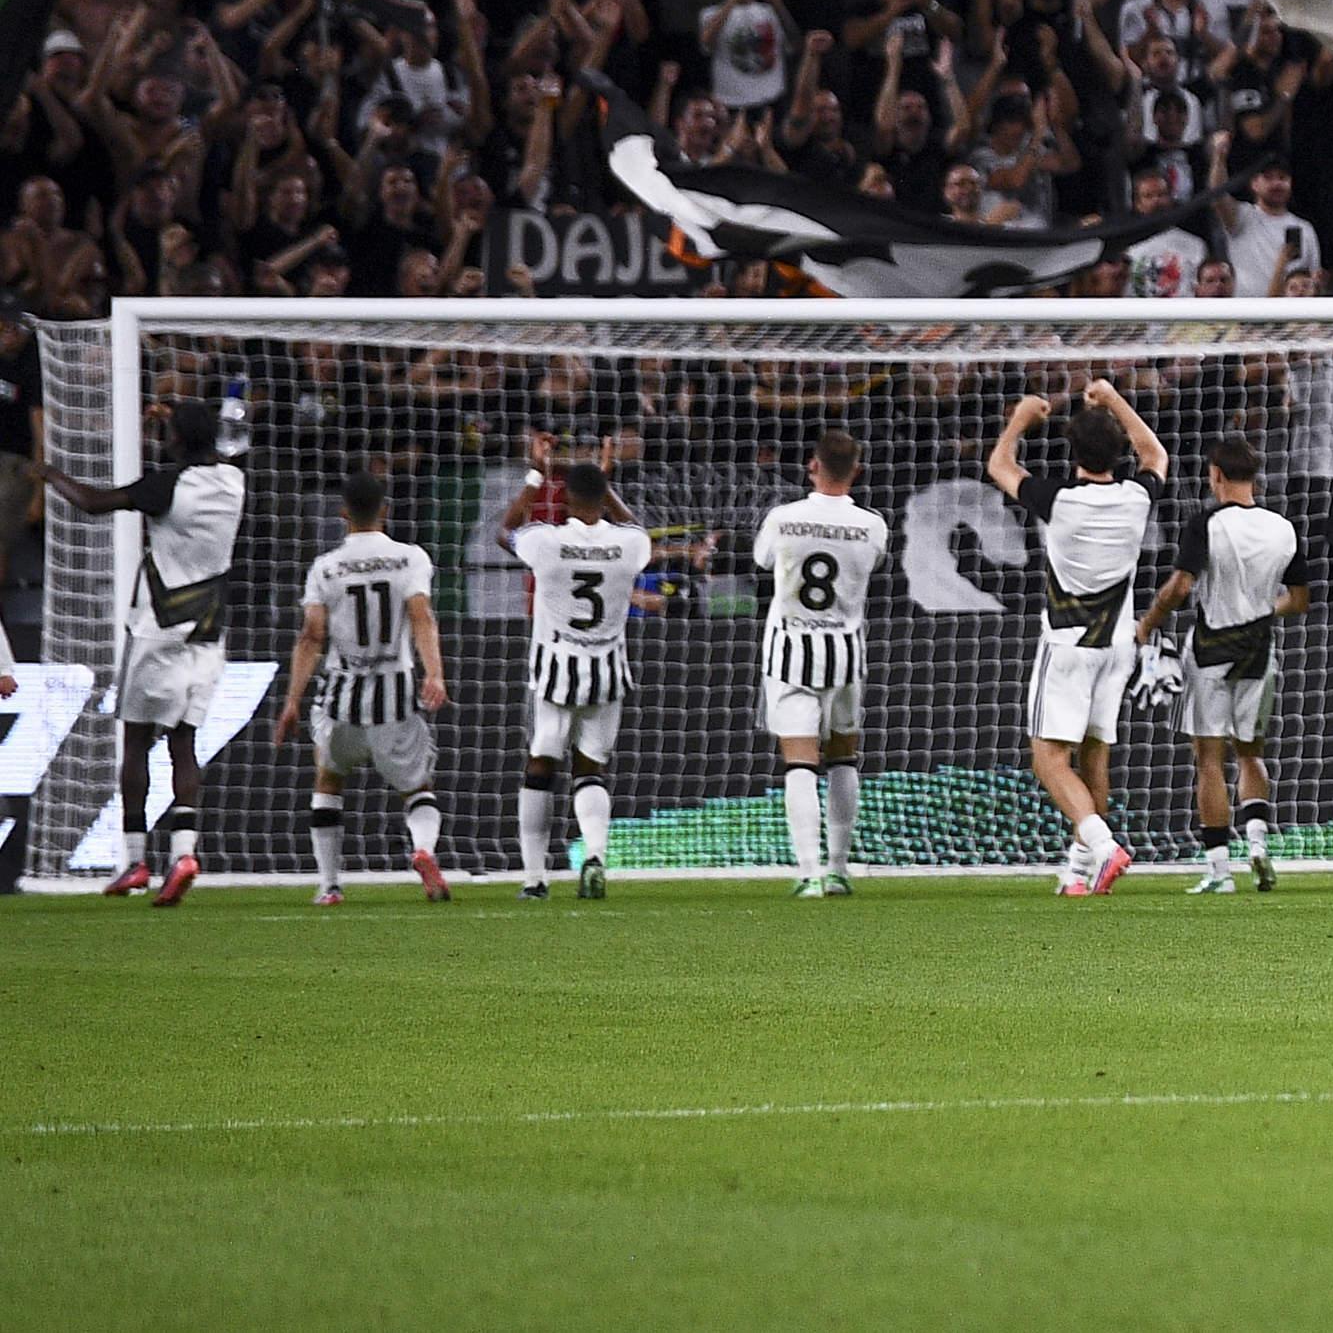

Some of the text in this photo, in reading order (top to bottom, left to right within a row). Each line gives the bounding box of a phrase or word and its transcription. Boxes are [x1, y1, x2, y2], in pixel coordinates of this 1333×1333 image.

[568, 569, 605, 631] 3
[798, 550, 840, 612] 8
[345, 580, 392, 648] 11
